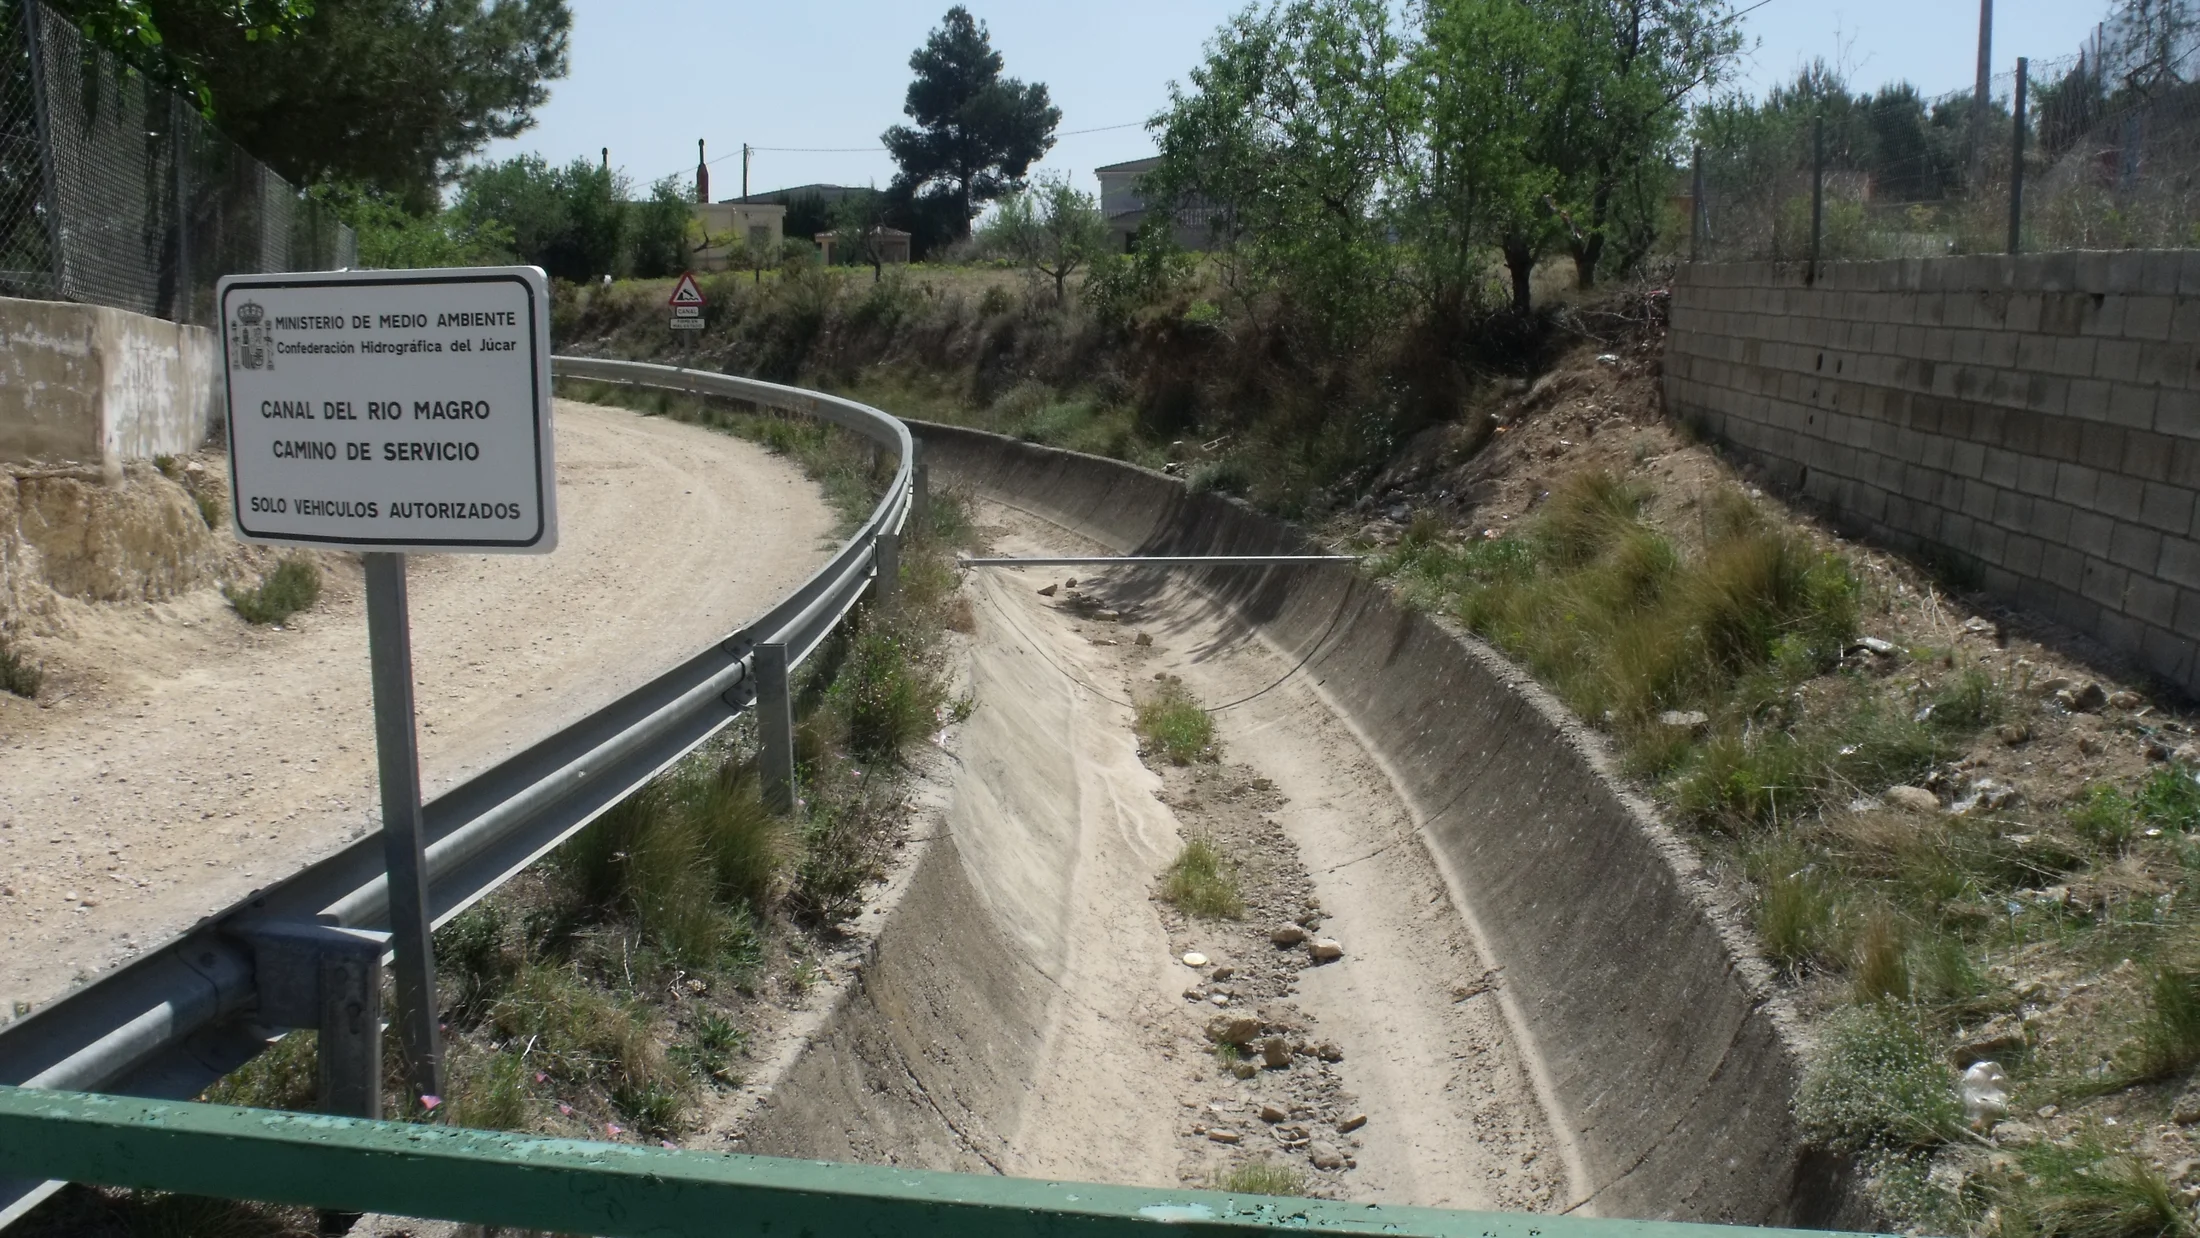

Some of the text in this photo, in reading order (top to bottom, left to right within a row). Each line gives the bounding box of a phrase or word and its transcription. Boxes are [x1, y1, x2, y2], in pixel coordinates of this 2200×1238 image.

[276, 312, 515, 329] MINISTERIO DE MEDIO AMBIENTE
[277, 338, 517, 355] Confederación Hidrográfica del Júcar
[262, 401, 489, 420] CANAL DEL RIO MAGRO
[273, 441, 479, 461] CAMINO DE SERVICIO
[251, 497, 520, 519] SOLO VEHICULOS AUTORIZADOS
